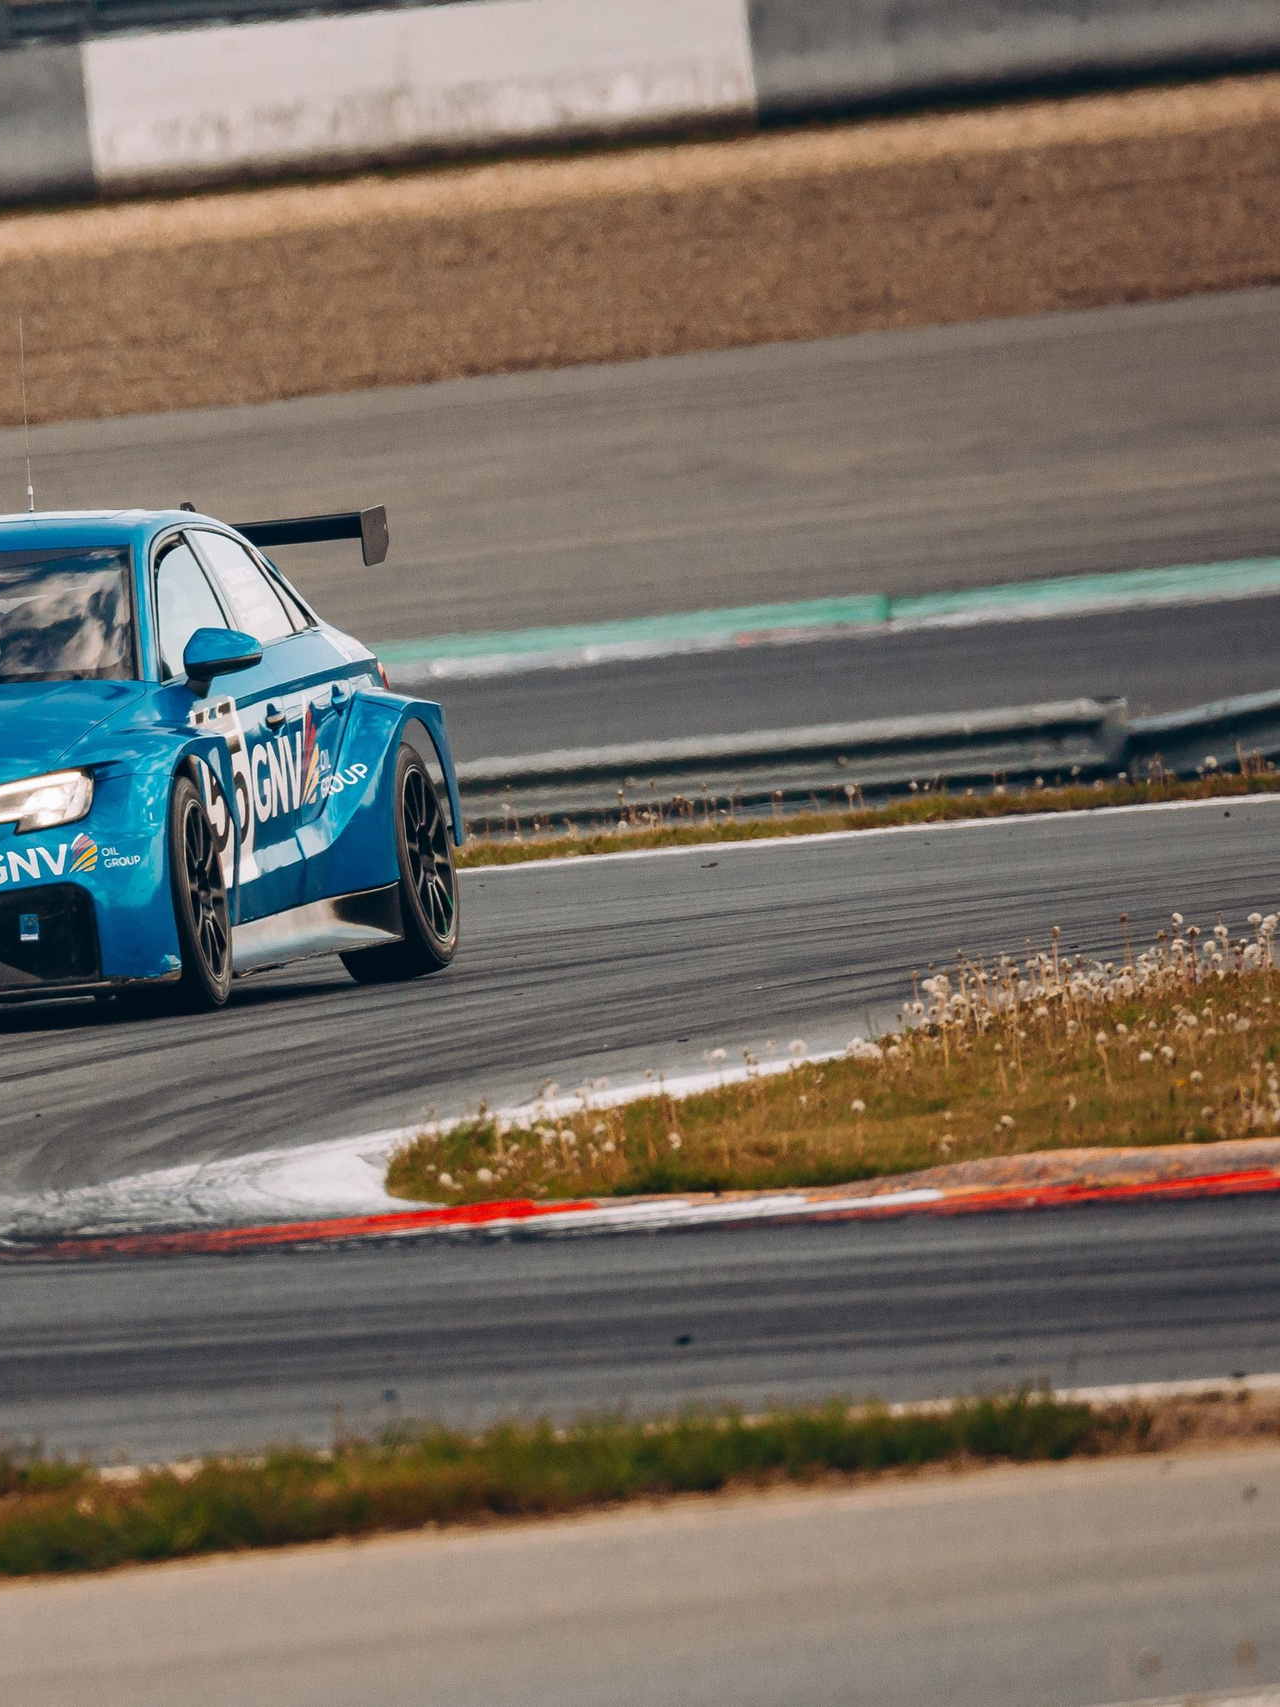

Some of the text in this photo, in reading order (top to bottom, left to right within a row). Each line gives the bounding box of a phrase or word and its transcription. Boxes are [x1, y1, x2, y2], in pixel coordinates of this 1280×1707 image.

[251, 731, 303, 823] GNV
[101, 847, 120, 857] OIL
[103, 855, 141, 869] GROUP
